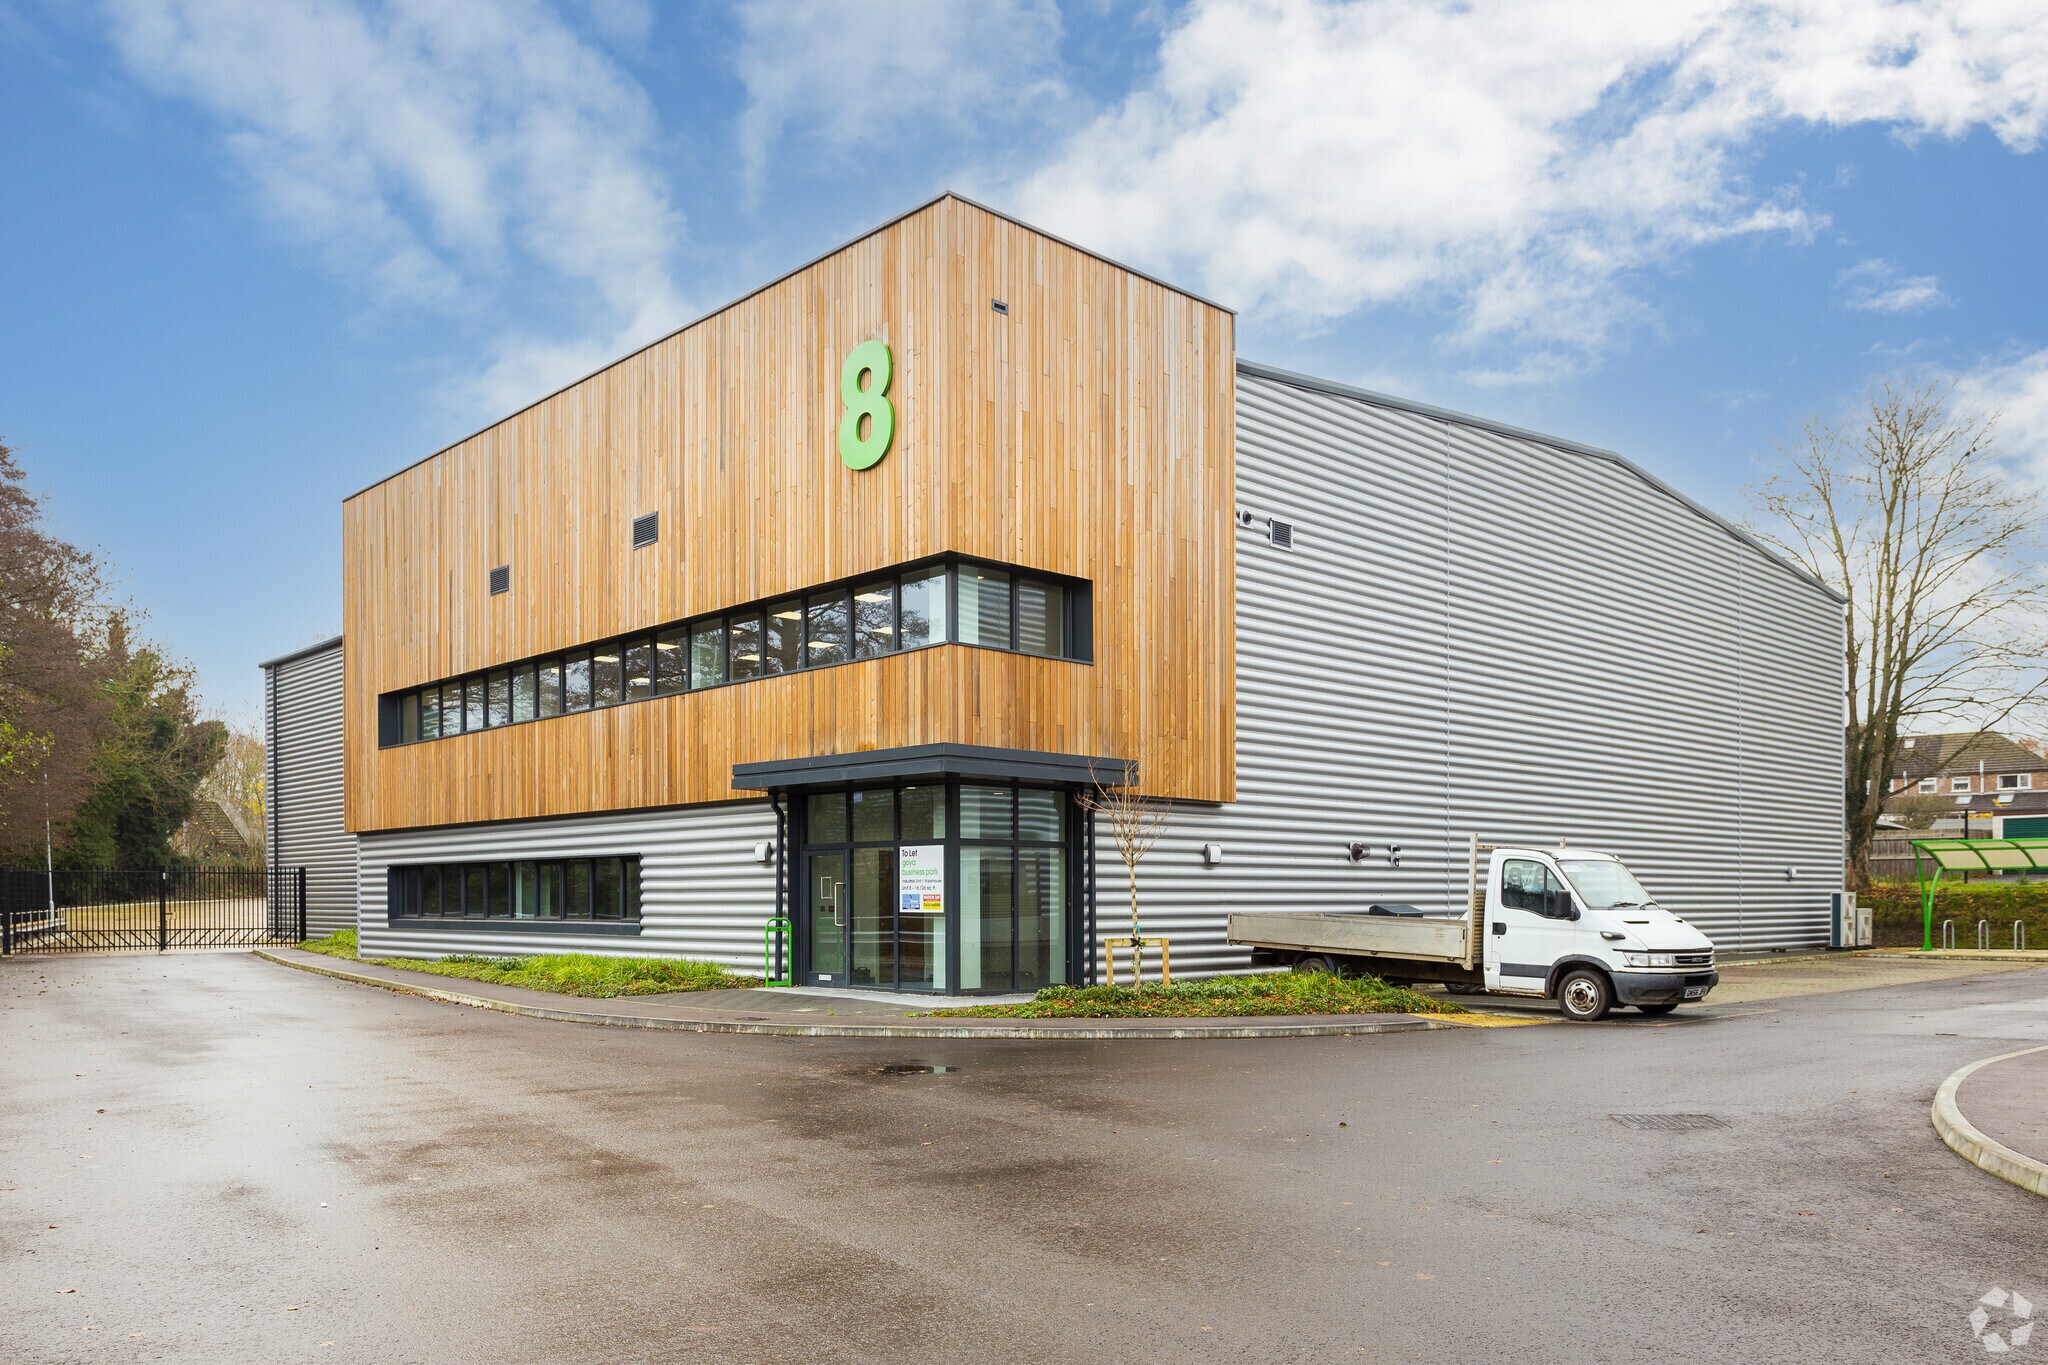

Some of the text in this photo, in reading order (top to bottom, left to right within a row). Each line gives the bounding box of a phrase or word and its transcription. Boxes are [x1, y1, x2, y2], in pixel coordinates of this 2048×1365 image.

[839, 340, 894, 471] 8
[902, 860, 916, 868] goya
[926, 868, 938, 876] park
